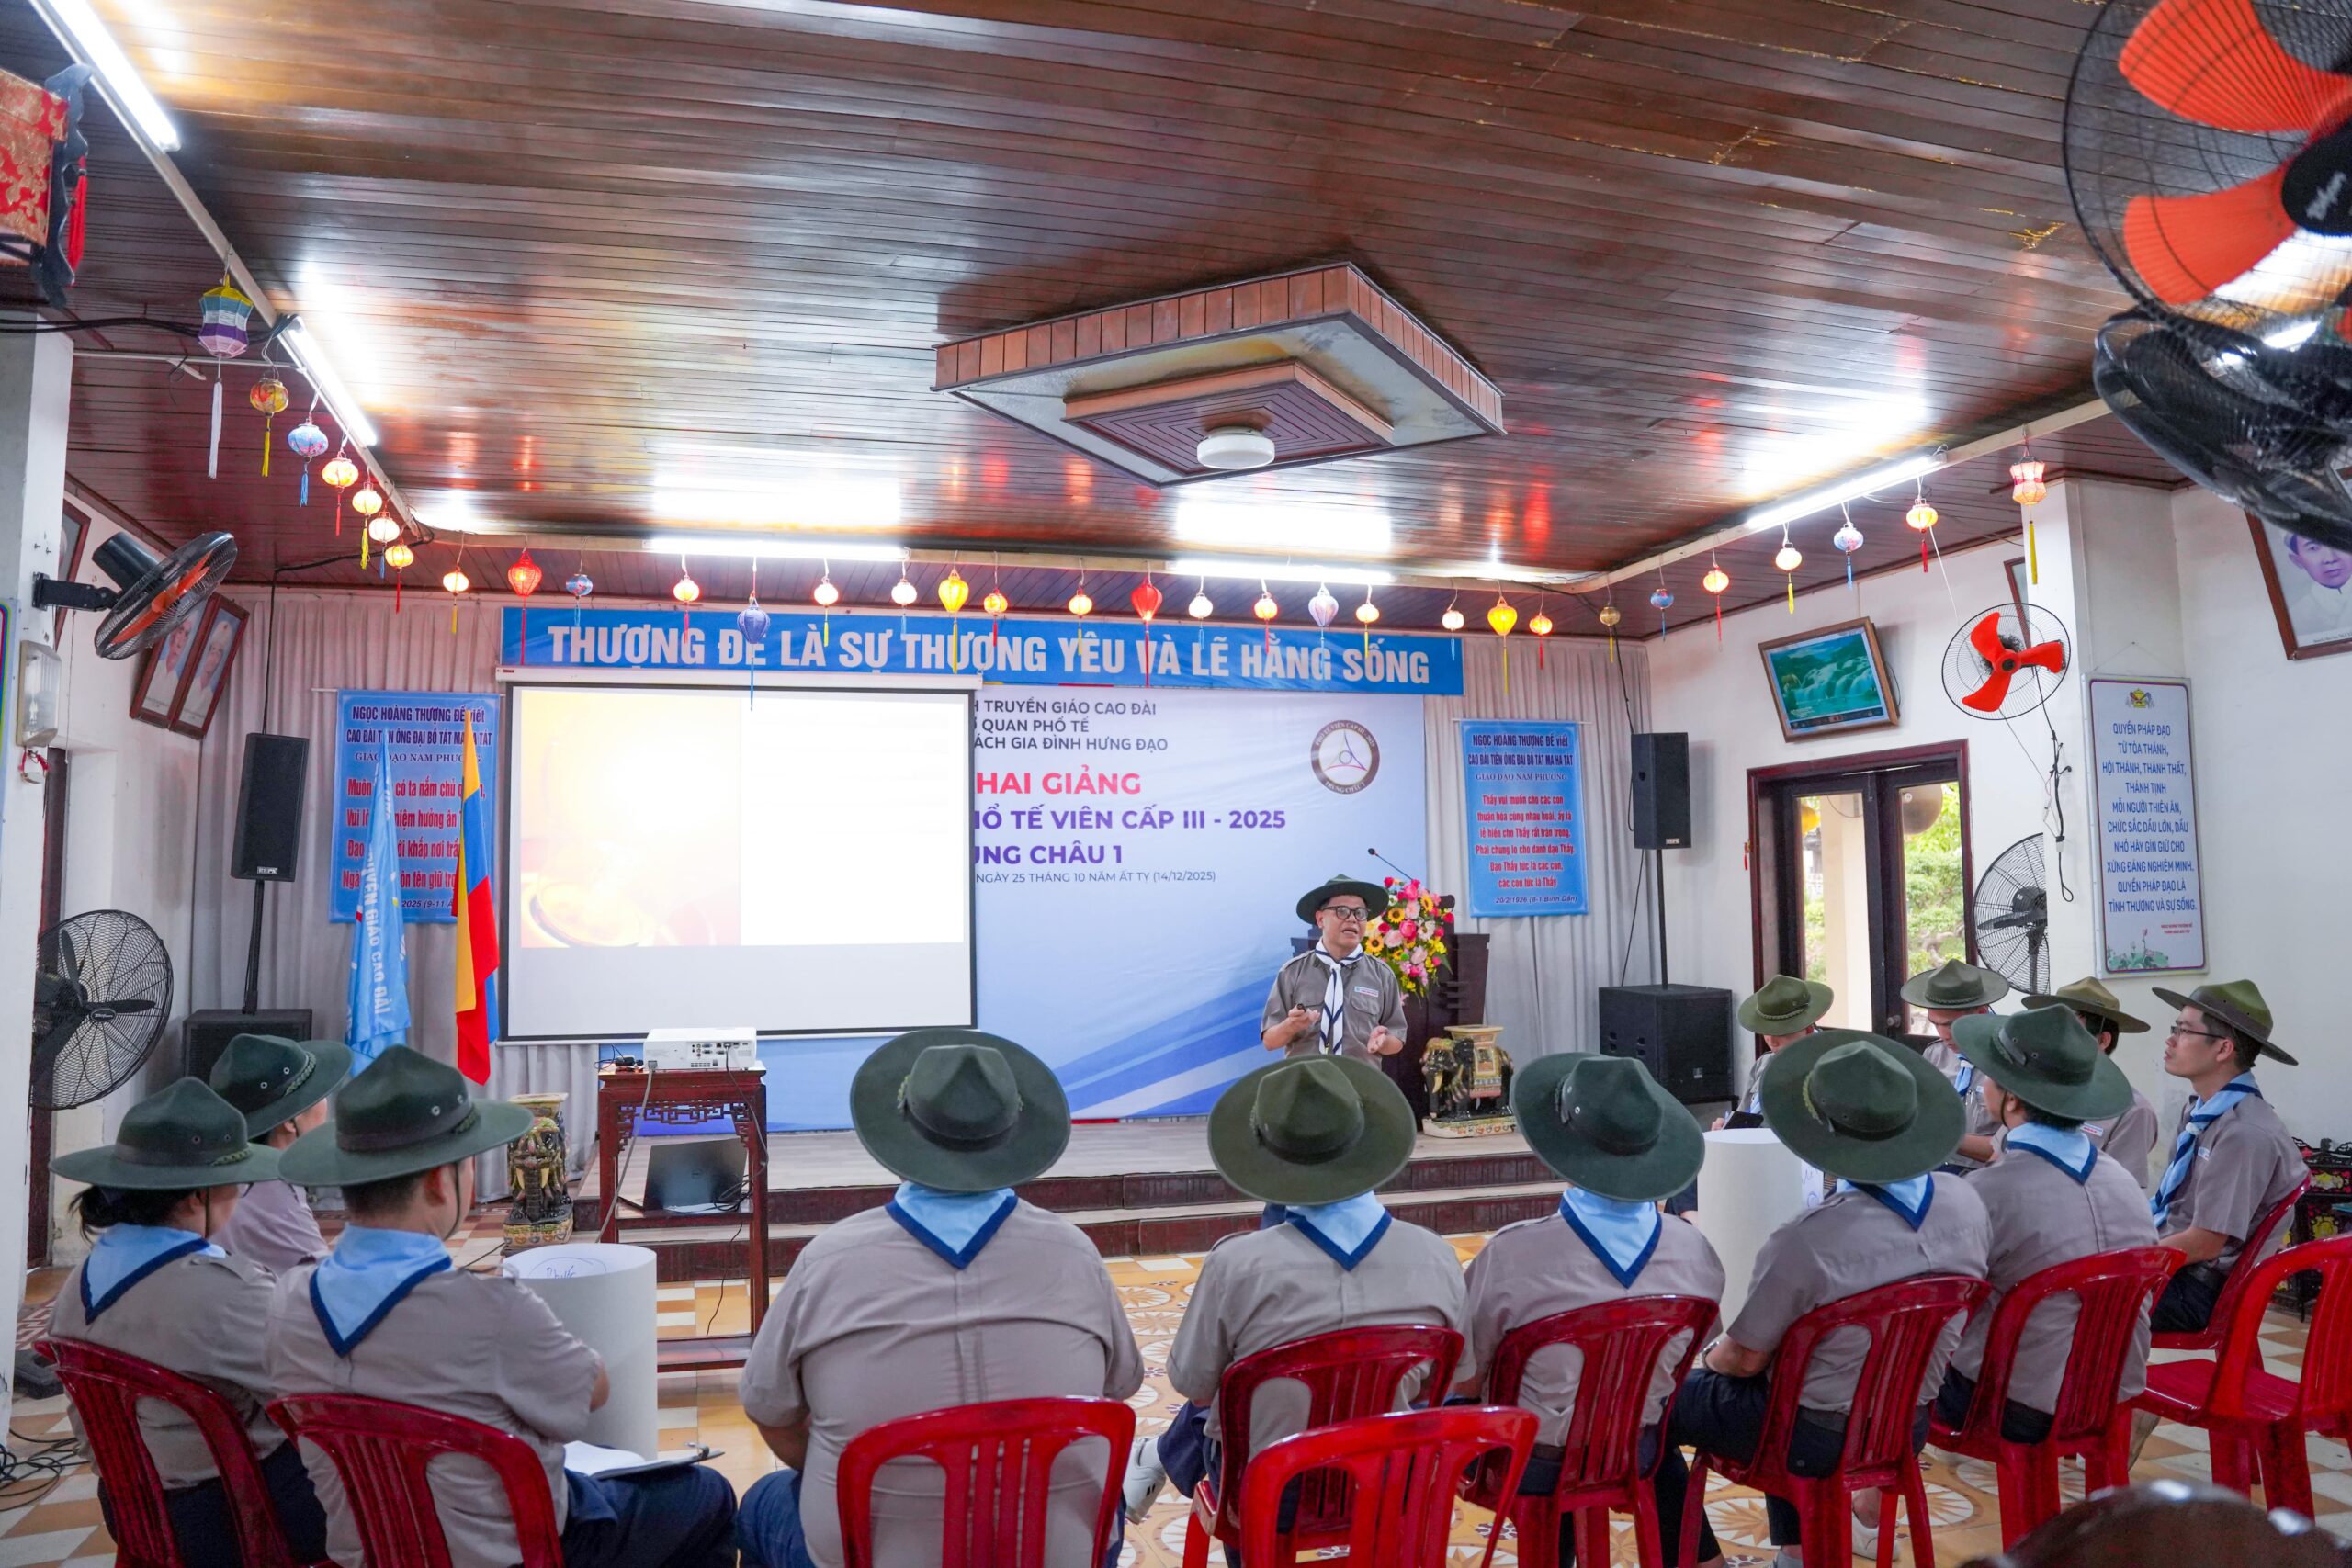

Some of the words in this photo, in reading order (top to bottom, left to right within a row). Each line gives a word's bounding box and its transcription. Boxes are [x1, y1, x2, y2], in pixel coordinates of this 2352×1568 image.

[548, 624, 706, 669] THƯỢNG
[781, 624, 826, 667] LÀ
[840, 629, 893, 674] SỰ
[900, 630, 1046, 671] THƯƠNG
[1058, 631, 1124, 674] YÊU
[1136, 634, 1181, 676] VÀ
[1192, 637, 1229, 677] LẼ
[1241, 633, 1331, 681] HẰNG
[1343, 638, 1429, 684] SỐNG
[352, 705, 379, 724] NGỌC
[380, 705, 413, 721] HOÀNG
[415, 707, 451, 725] THƯỢNG
[454, 705, 466, 722] ĐẾ
[984, 697, 1046, 714] TRUYỀN
[1051, 699, 1090, 715] GIÁO
[1094, 702, 1126, 715] CAO
[1131, 700, 1157, 716] ĐÀI
[982, 718, 1027, 734] QUAN
[1033, 716, 1066, 732] PHỔ
[1070, 716, 1089, 732] TẾ
[2137, 723, 2156, 736] PHÁP
[2157, 725, 2171, 739] ĐẠO
[346, 729, 361, 743] CAO
[363, 727, 376, 743] ĐÀI
[396, 728, 412, 744] ÔNG
[413, 730, 425, 747] ĐẠI
[974, 734, 1006, 750] ÁCH
[1011, 737, 1037, 750] GIA
[1043, 734, 1080, 750] ĐÌNH
[1086, 736, 1131, 750] HƯNG
[1136, 738, 1169, 753] ĐẠO
[1473, 734, 1491, 749] NGỌC
[1494, 732, 1516, 746] HOÀNG
[410, 753, 433, 762] NAM
[2118, 741, 2127, 754] TỪ
[2128, 742, 2142, 755] TÒA
[2143, 742, 2169, 757] THÁNH,
[2102, 760, 2114, 776] HỘI
[2116, 761, 2142, 775] THÁNH,
[2143, 761, 2166, 774] THÁNH
[2167, 761, 2187, 776] THẤT,
[395, 778, 406, 797] có
[408, 780, 417, 797] ta
[419, 775, 437, 797] nắm
[440, 778, 456, 797] chủ
[977, 773, 1031, 795] HAI
[1042, 764, 1141, 795] GIẢNG
[2125, 780, 2149, 794] THÁNH
[2150, 782, 2166, 796] TỊNH
[1553, 796, 1564, 805] con
[2112, 797, 2125, 813] MỖI
[2126, 800, 2148, 813] NGƯỜI
[2149, 800, 2169, 814] THIÊN
[2170, 800, 2182, 815] ÂN,
[346, 808, 359, 826] Vui
[394, 809, 416, 830] niệm
[418, 807, 444, 830] hưởng
[447, 809, 457, 828] ân
[1011, 803, 1045, 829] TẾ
[1051, 806, 1113, 829] VIÊN
[1122, 804, 1174, 829] CẤP
[1183, 810, 1204, 829] III
[1228, 810, 1285, 829] 2025
[2108, 819, 2127, 833] CHỨC
[2128, 818, 2143, 833] SẮC
[2158, 818, 2174, 835] LỚN,
[347, 840, 365, 861] Đạo
[408, 836, 428, 859] khắp
[431, 840, 445, 857] nơi
[447, 837, 459, 857] trầ
[1029, 840, 1104, 864] CHÂU
[1114, 845, 1122, 863] 1
[2114, 840, 2130, 852] NHỎ
[2130, 839, 2143, 852] HÃY
[2145, 839, 2157, 852] GÌN
[2158, 839, 2170, 852] GIỮ
[2171, 840, 2185, 852] CHO
[2107, 859, 2126, 873] XỨNG
[2127, 859, 2146, 873] ĐÁNG
[2147, 858, 2174, 873] NGHIÊM
[343, 870, 359, 890] Ngà
[413, 871, 426, 888] tên
[429, 871, 443, 890] giữ
[976, 870, 1009, 883] NGÀY
[1012, 874, 1025, 883] 25
[1028, 871, 1070, 883] THÁNG
[1074, 873, 1085, 882] 10
[1089, 871, 1115, 882] NĂM
[1153, 870, 1216, 883] (14/12/2025)
[2143, 877, 2161, 892] PHÁP
[2162, 881, 2176, 895] ĐẠO
[2177, 877, 2187, 891] LÀ
[2108, 898, 2125, 913] TÌNH
[2126, 900, 2155, 912] THƯƠNG
[2155, 897, 2165, 911] VÀ
[2165, 899, 2176, 914] SỰ
[2177, 896, 2197, 911] SỐNG.
